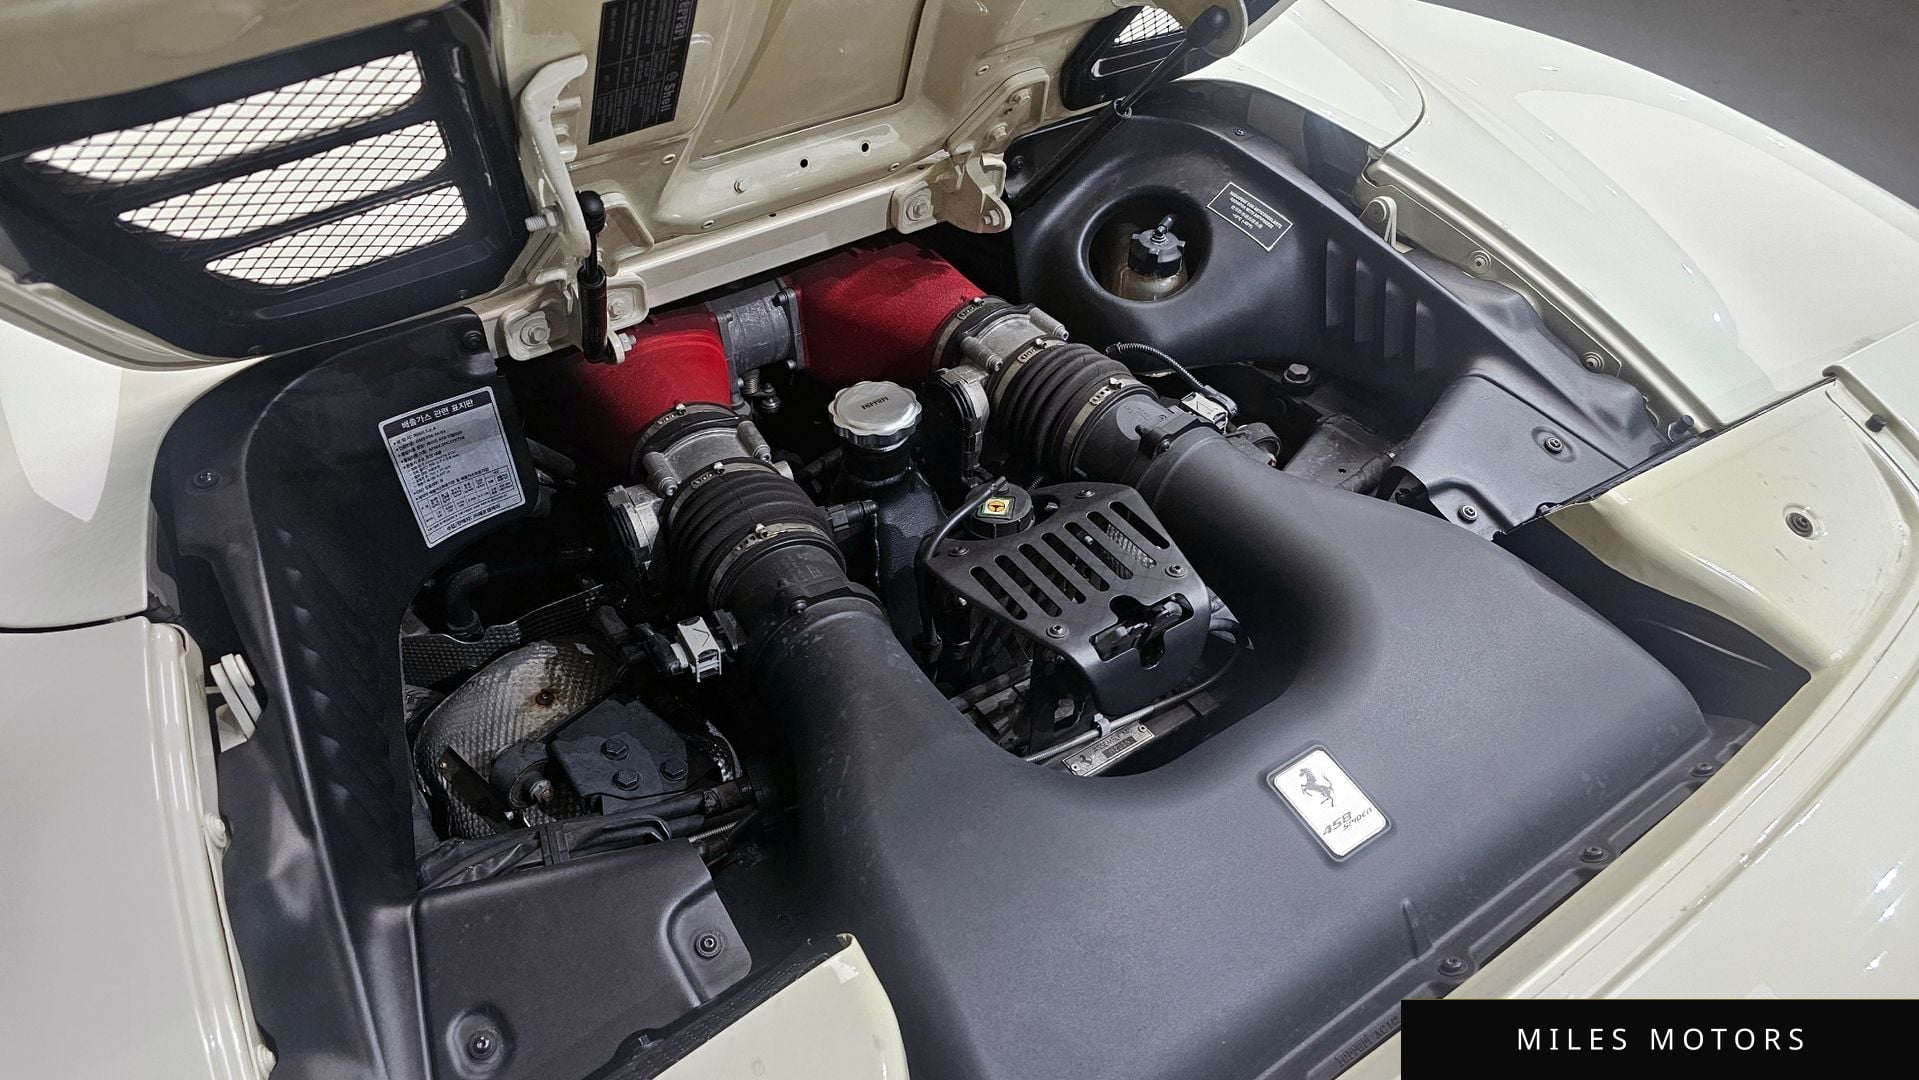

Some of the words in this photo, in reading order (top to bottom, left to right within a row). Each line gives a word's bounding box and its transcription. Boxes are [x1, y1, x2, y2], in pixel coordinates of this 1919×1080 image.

[673, 0, 691, 41] errari
[661, 82, 677, 112] Shell
[400, 414, 433, 430] 배출가스
[433, 406, 450, 419] 관련
[451, 399, 474, 413] 표지판
[861, 396, 889, 410] Ferrari
[1322, 811, 1352, 836] 458
[1342, 807, 1373, 832] SPIDER
